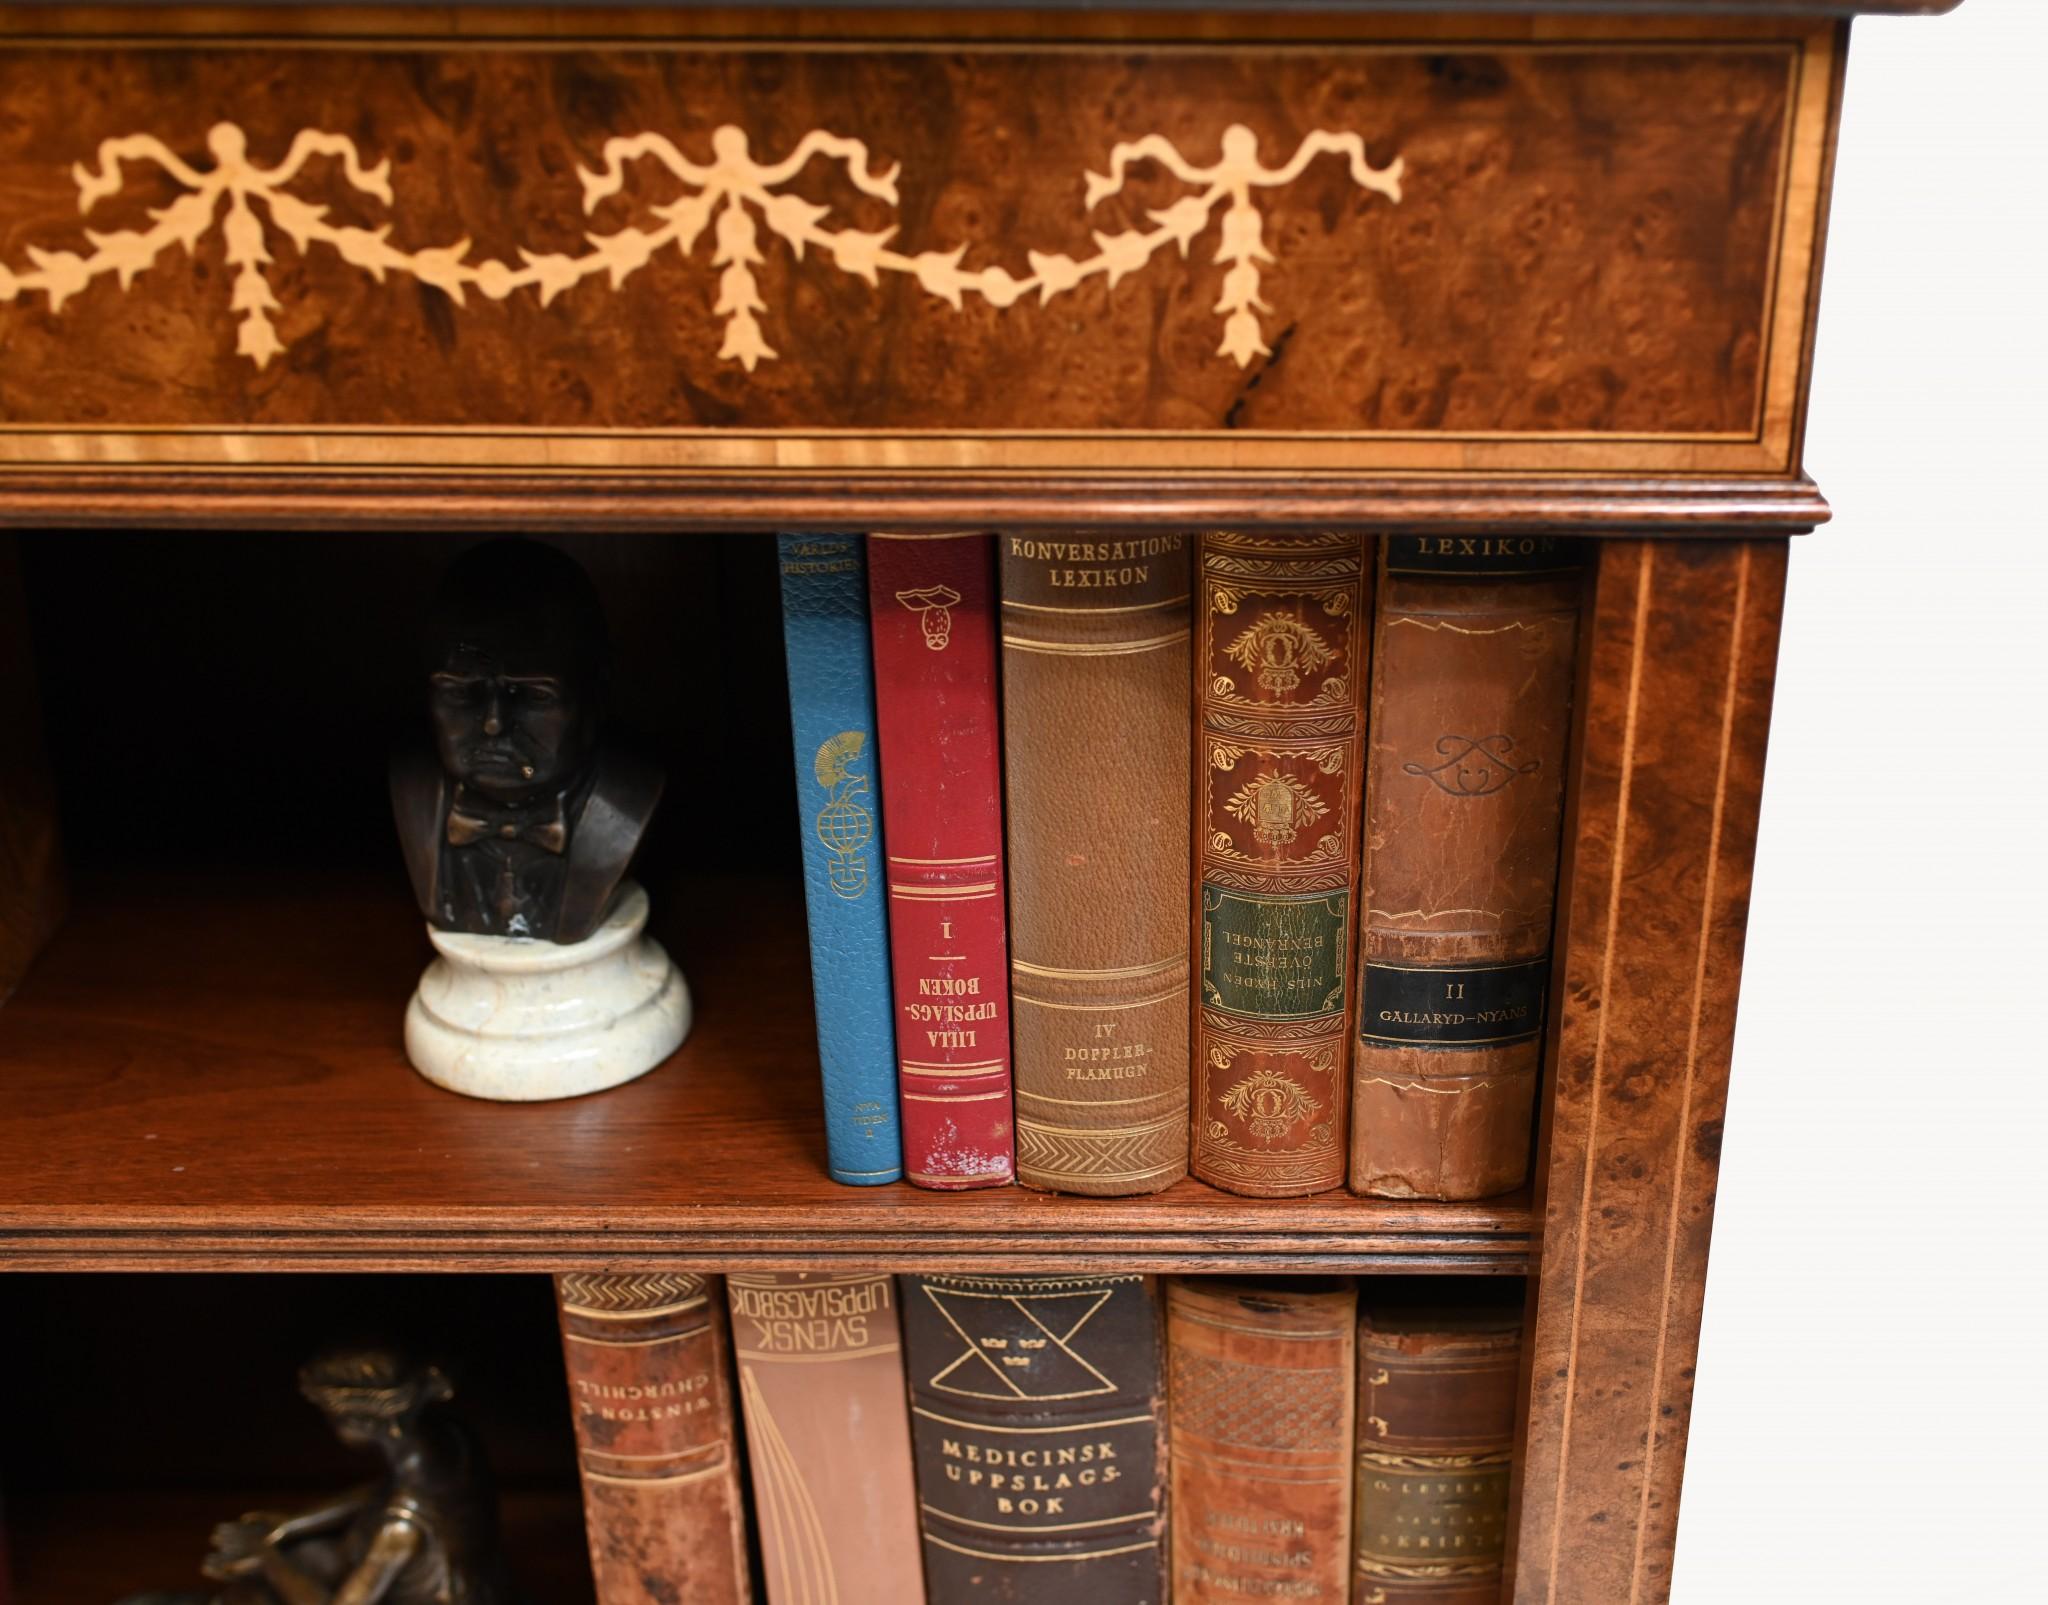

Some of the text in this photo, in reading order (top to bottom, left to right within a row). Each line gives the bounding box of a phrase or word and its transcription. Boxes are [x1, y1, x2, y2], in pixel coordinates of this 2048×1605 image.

[1010, 533, 1182, 561] KONVERSATIONS
[1417, 537, 1555, 556] LEXIKON
[1049, 566, 1149, 587] LEXIKON
[919, 977, 980, 996] BOKEN
[1287, 976, 1323, 990] NILS
[1446, 983, 1465, 999] II
[904, 1001, 998, 1022] UPPSLAGS-
[926, 1030, 977, 1048] LILLA
[1095, 1023, 1116, 1038] IV
[1064, 1043, 1153, 1061] DOPPLER-
[1066, 1064, 1148, 1080] FLAMUGN
[728, 1281, 889, 1320] UPPSLAGSBOK
[752, 1316, 869, 1350] SVENSK
[576, 1374, 709, 1401] CHURCHILL
[601, 1397, 710, 1421] WINSTON
[942, 1438, 1117, 1467] MEDICINSK
[945, 1463, 1121, 1491] UPPSLAGS-
[998, 1497, 1064, 1515] BOK
